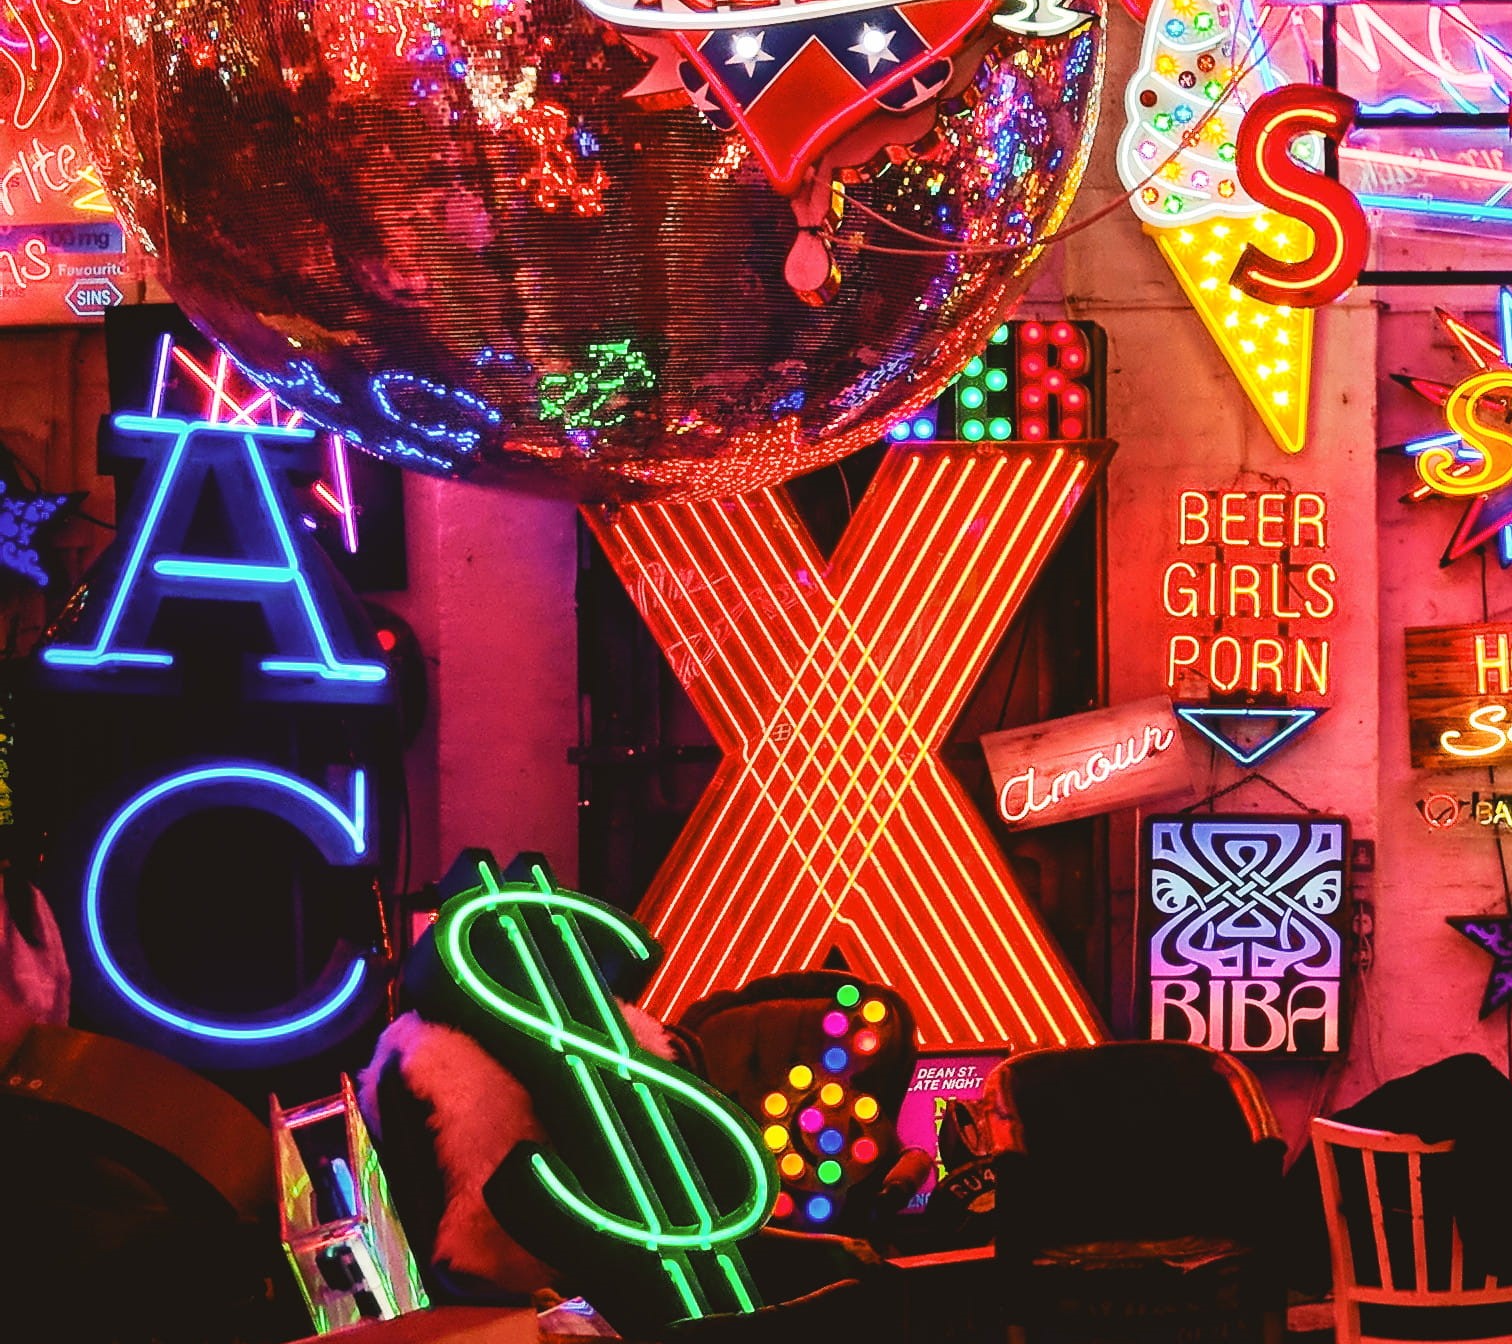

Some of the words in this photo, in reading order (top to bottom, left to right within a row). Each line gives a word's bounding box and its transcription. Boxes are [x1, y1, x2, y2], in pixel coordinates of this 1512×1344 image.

[76, 290, 112, 307] SINS
[1178, 491, 1329, 548] BEER
[1162, 562, 1338, 619] GIRLS
[1166, 635, 1329, 696] PORN
[1150, 978, 1340, 1053] BIBA
[908, 1079, 940, 1092] ATE
[941, 1078, 984, 1090] NIGHT
[917, 1067, 956, 1079] DEAN
